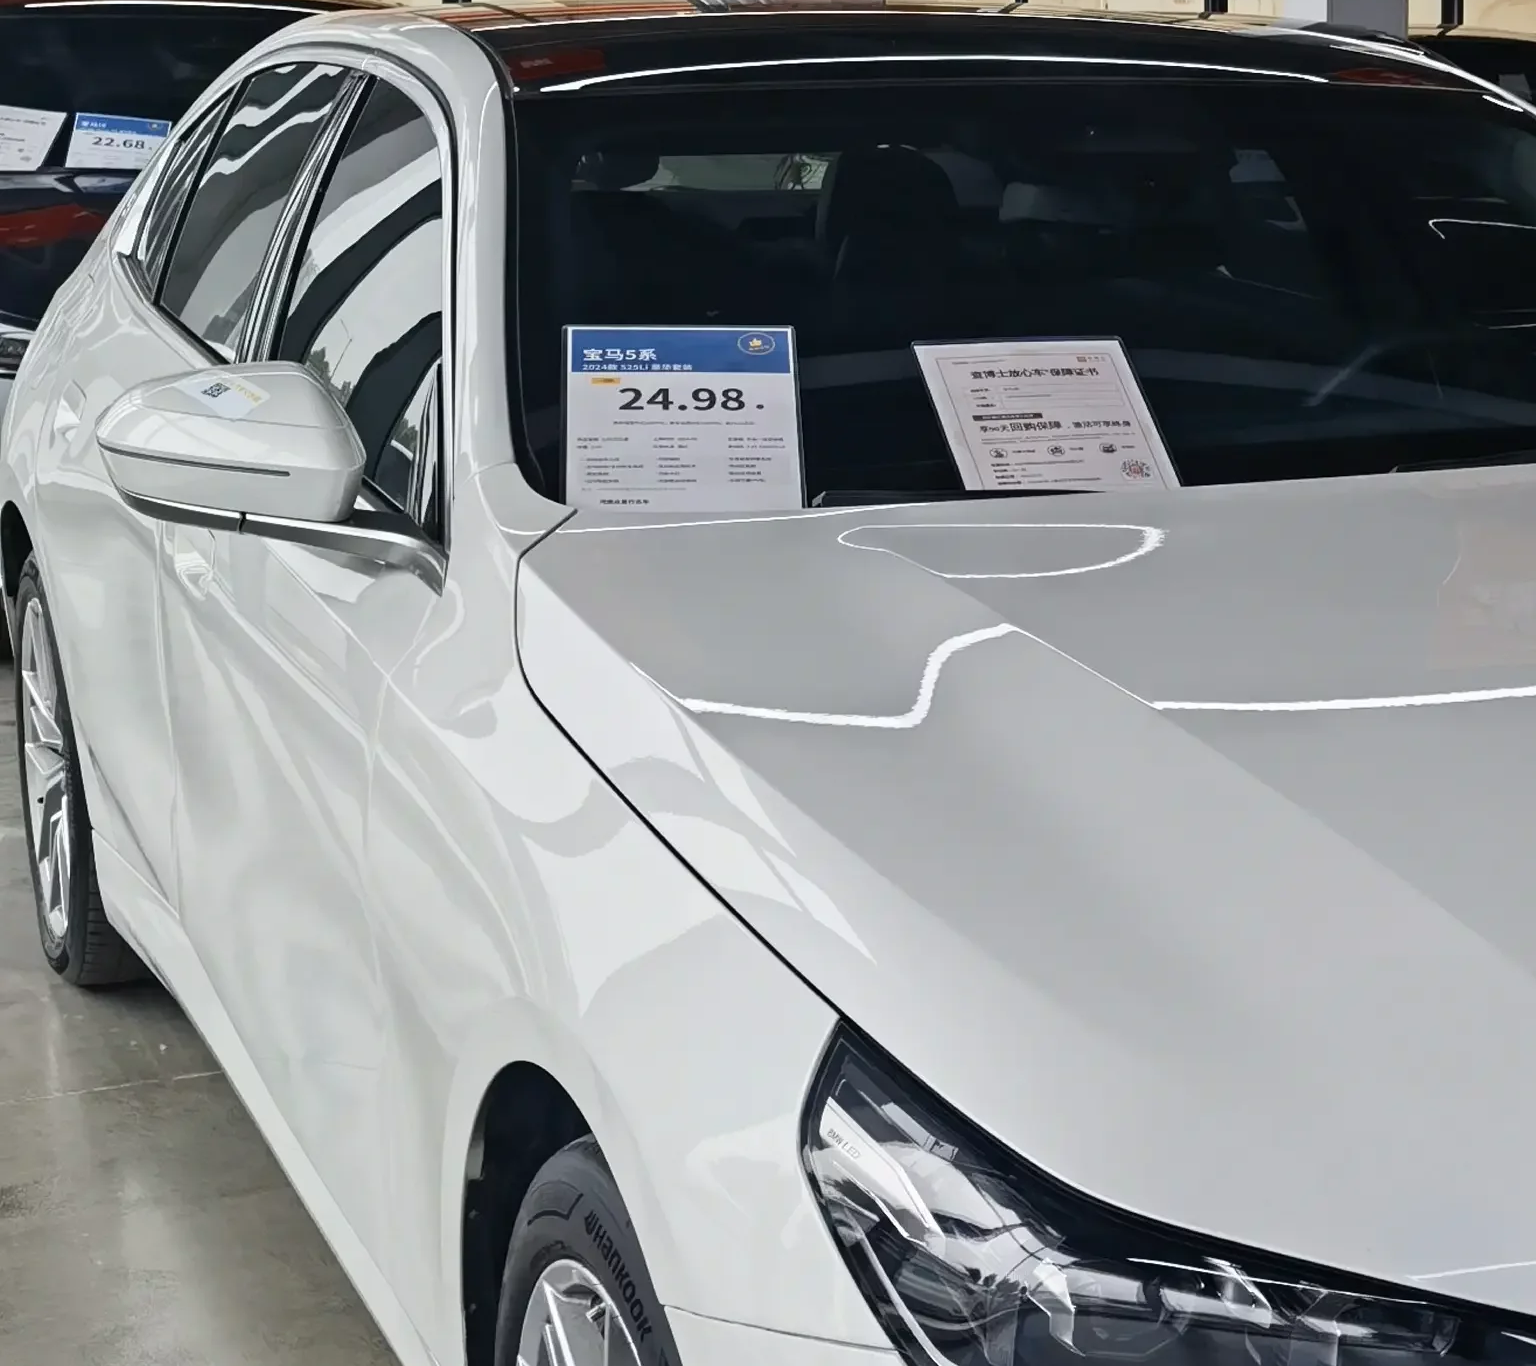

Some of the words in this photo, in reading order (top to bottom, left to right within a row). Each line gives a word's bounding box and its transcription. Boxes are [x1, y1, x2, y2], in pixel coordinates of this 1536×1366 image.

[91, 136, 146, 150] 22.68
[582, 348, 658, 362] 宝马5系
[842, 1141, 861, 1158] LED
